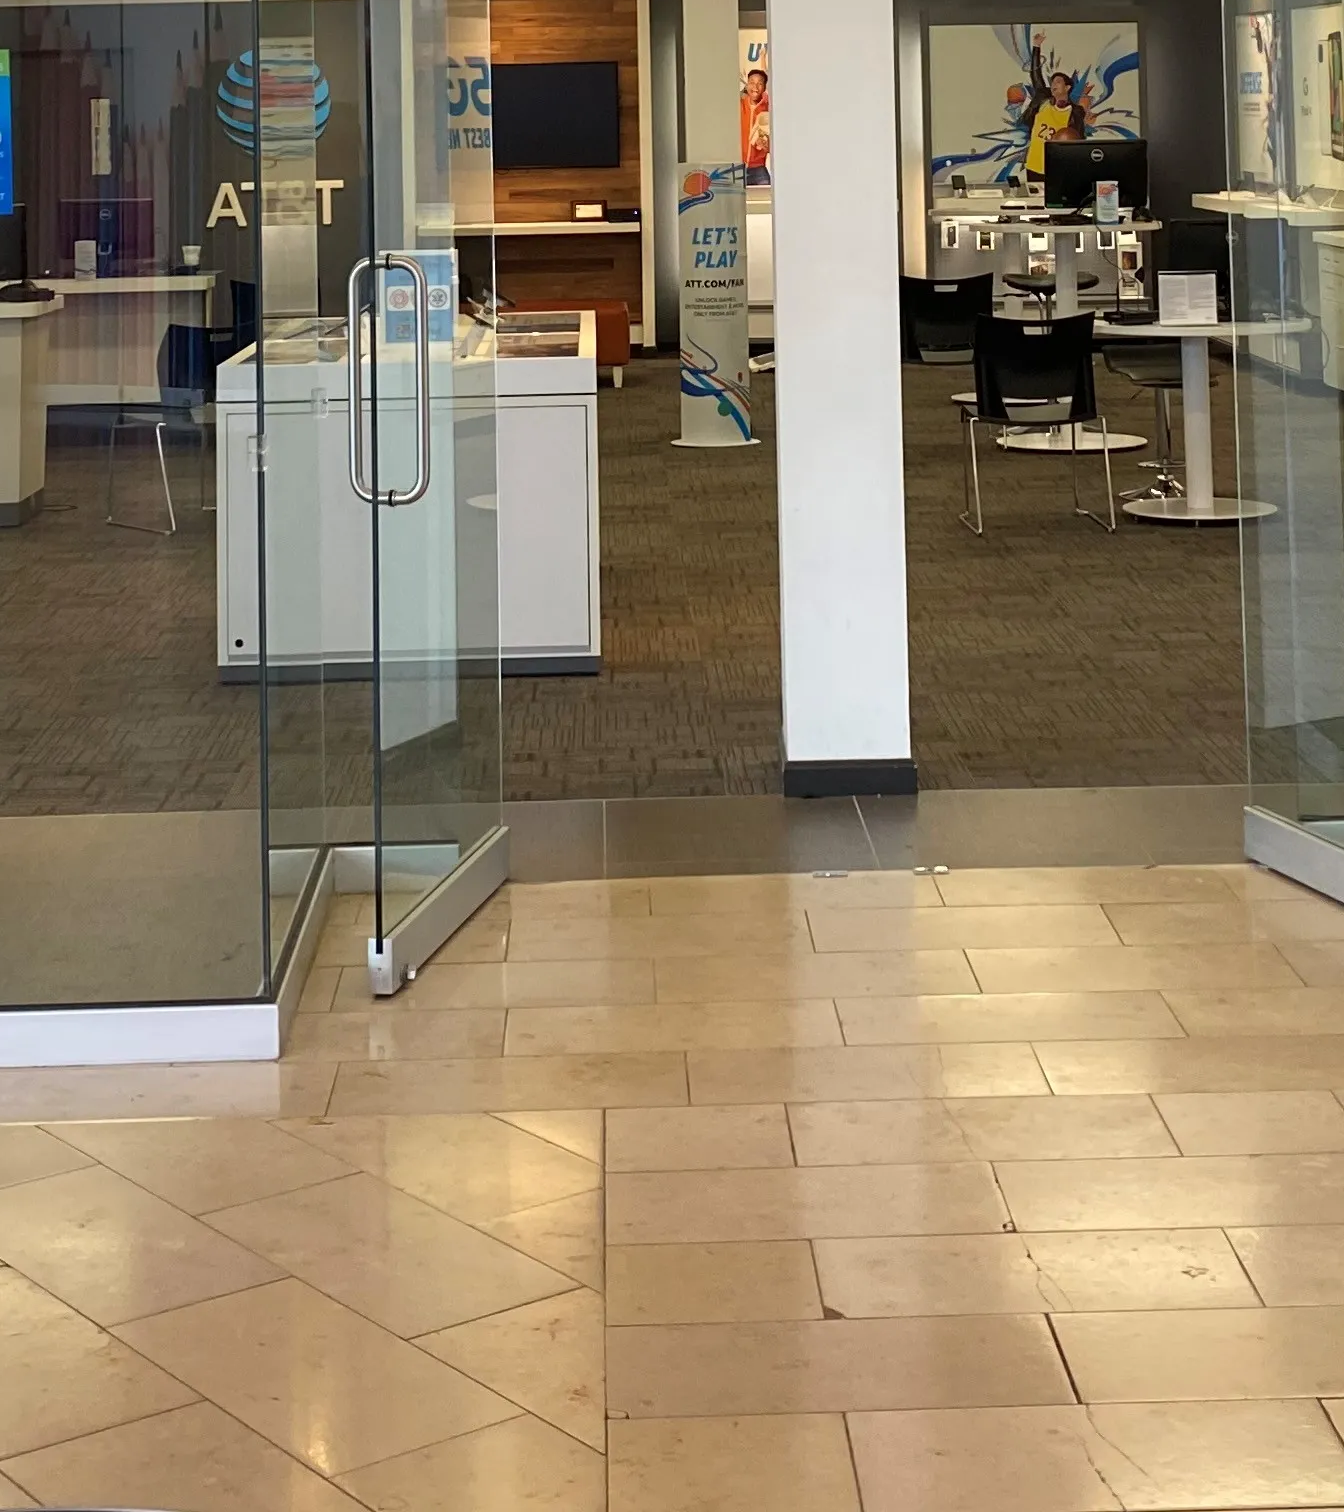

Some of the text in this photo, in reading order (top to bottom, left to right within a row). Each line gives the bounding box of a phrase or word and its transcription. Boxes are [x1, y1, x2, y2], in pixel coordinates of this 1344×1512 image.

[1038, 123, 1056, 140] 23
[692, 227, 738, 245] LET'S
[694, 250, 739, 269] PLAY
[685, 278, 744, 289] ATT.COM/FAN
